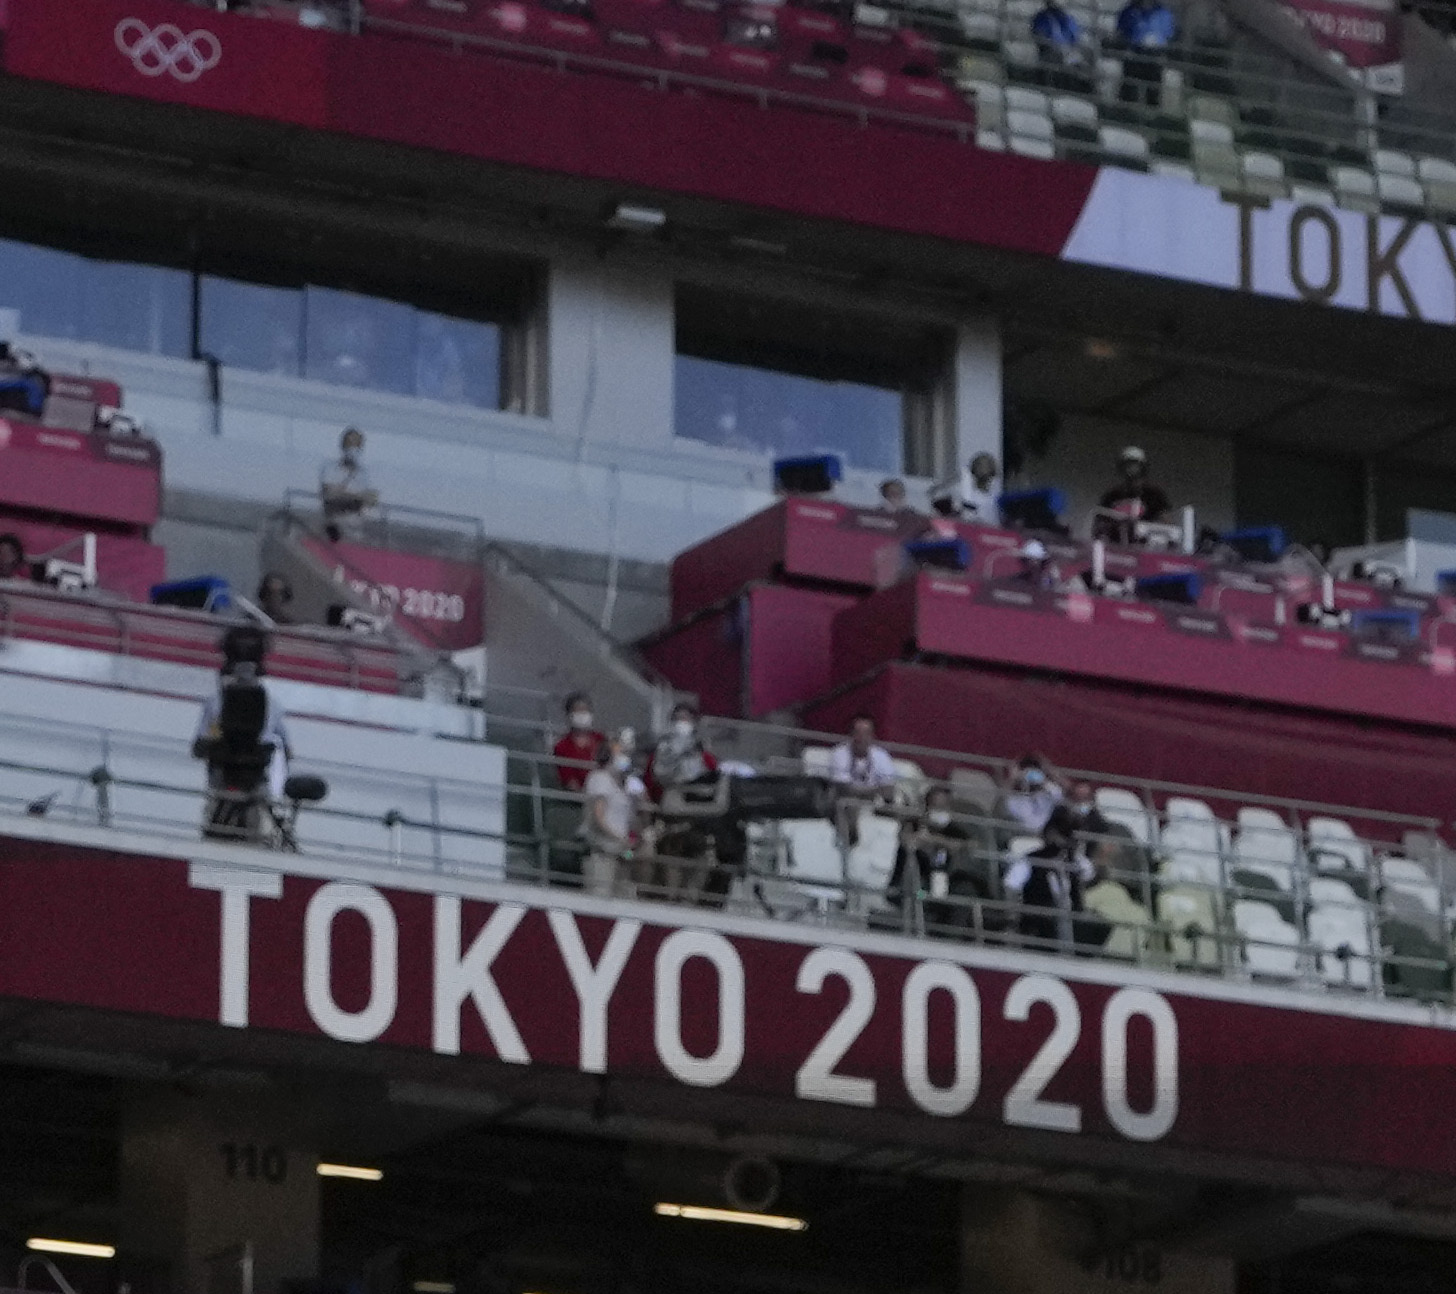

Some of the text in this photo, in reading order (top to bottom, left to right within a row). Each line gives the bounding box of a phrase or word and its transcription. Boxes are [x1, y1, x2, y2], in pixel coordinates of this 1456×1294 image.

[402, 585, 465, 622] 2020
[188, 863, 1179, 1141] TOKYO 2020
[219, 1144, 287, 1185] 110
